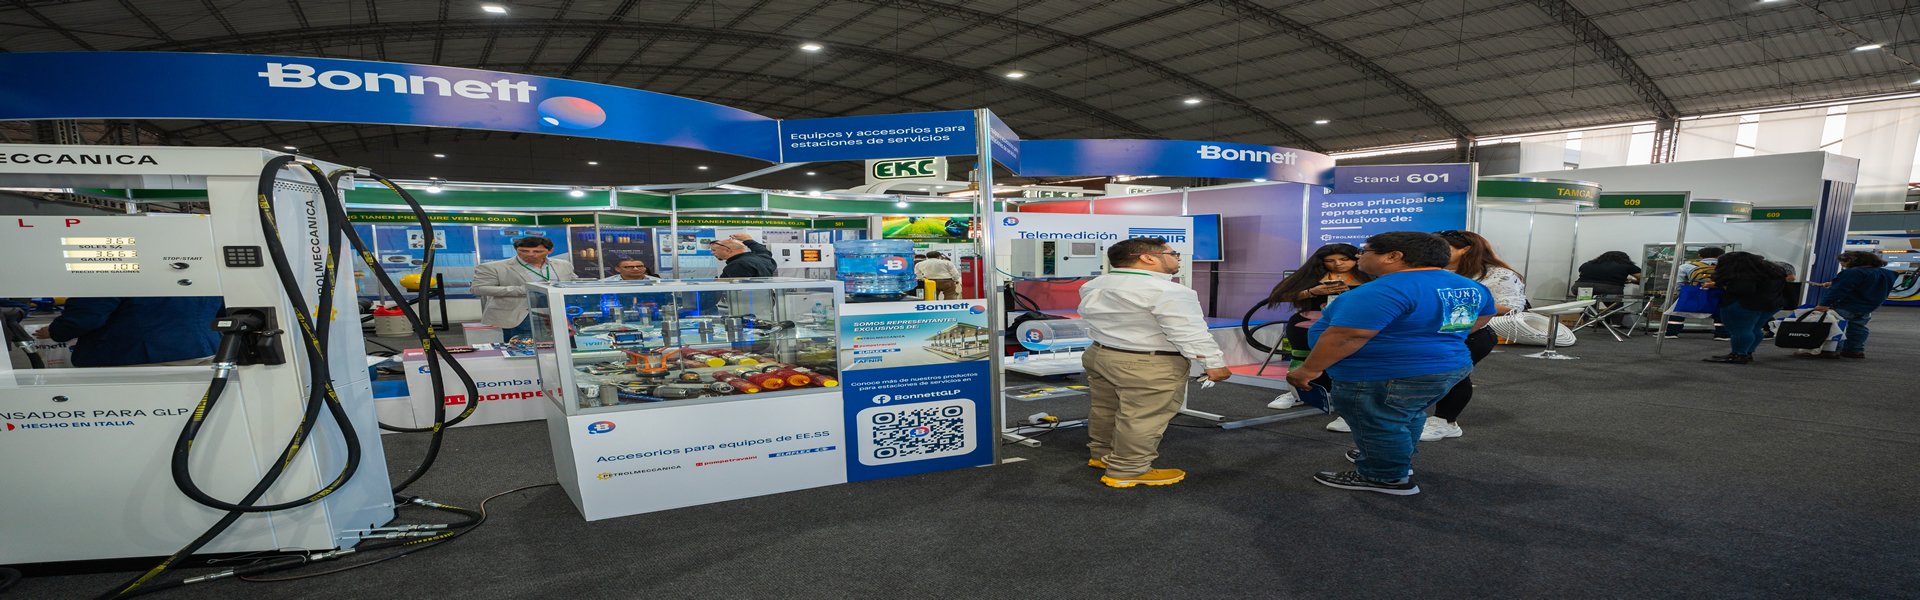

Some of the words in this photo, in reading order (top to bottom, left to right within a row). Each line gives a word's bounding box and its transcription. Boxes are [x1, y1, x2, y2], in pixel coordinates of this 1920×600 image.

[258, 62, 537, 104] Bonnett
[790, 131, 843, 140] Equipos
[856, 126, 931, 137] accesorios
[935, 124, 966, 134] para
[790, 137, 863, 149] estaciones
[866, 136, 884, 145] de
[886, 133, 950, 144] servicios
[1196, 144, 1298, 166] Bonnett
[876, 160, 935, 177] EKC
[1406, 173, 1450, 184] 601
[1321, 200, 1364, 208] Somos
[1367, 195, 1445, 207] principales
[1623, 198, 1641, 206] 609
[1321, 206, 1424, 217] representantes
[18, 218, 34, 227] L
[65, 218, 81, 227] P
[1320, 216, 1387, 225] exclusivos
[1018, 231, 1118, 240] Telemedición
[914, 302, 970, 311] Bonnett
[943, 372, 979, 380] productos
[476, 379, 532, 388] Bomba
[877, 382, 918, 390] estaciones
[894, 389, 961, 401] BonnettGLP
[93, 409, 147, 418] PARA
[152, 408, 189, 416] GLP
[596, 447, 681, 463] Accesorios
[684, 443, 715, 455] para
[718, 437, 773, 450] equipos
[775, 434, 792, 442] de
[795, 430, 830, 440] EE.SS
[602, 464, 682, 479] PETROLMECCANICA
[703, 455, 758, 466] pompetravaini
